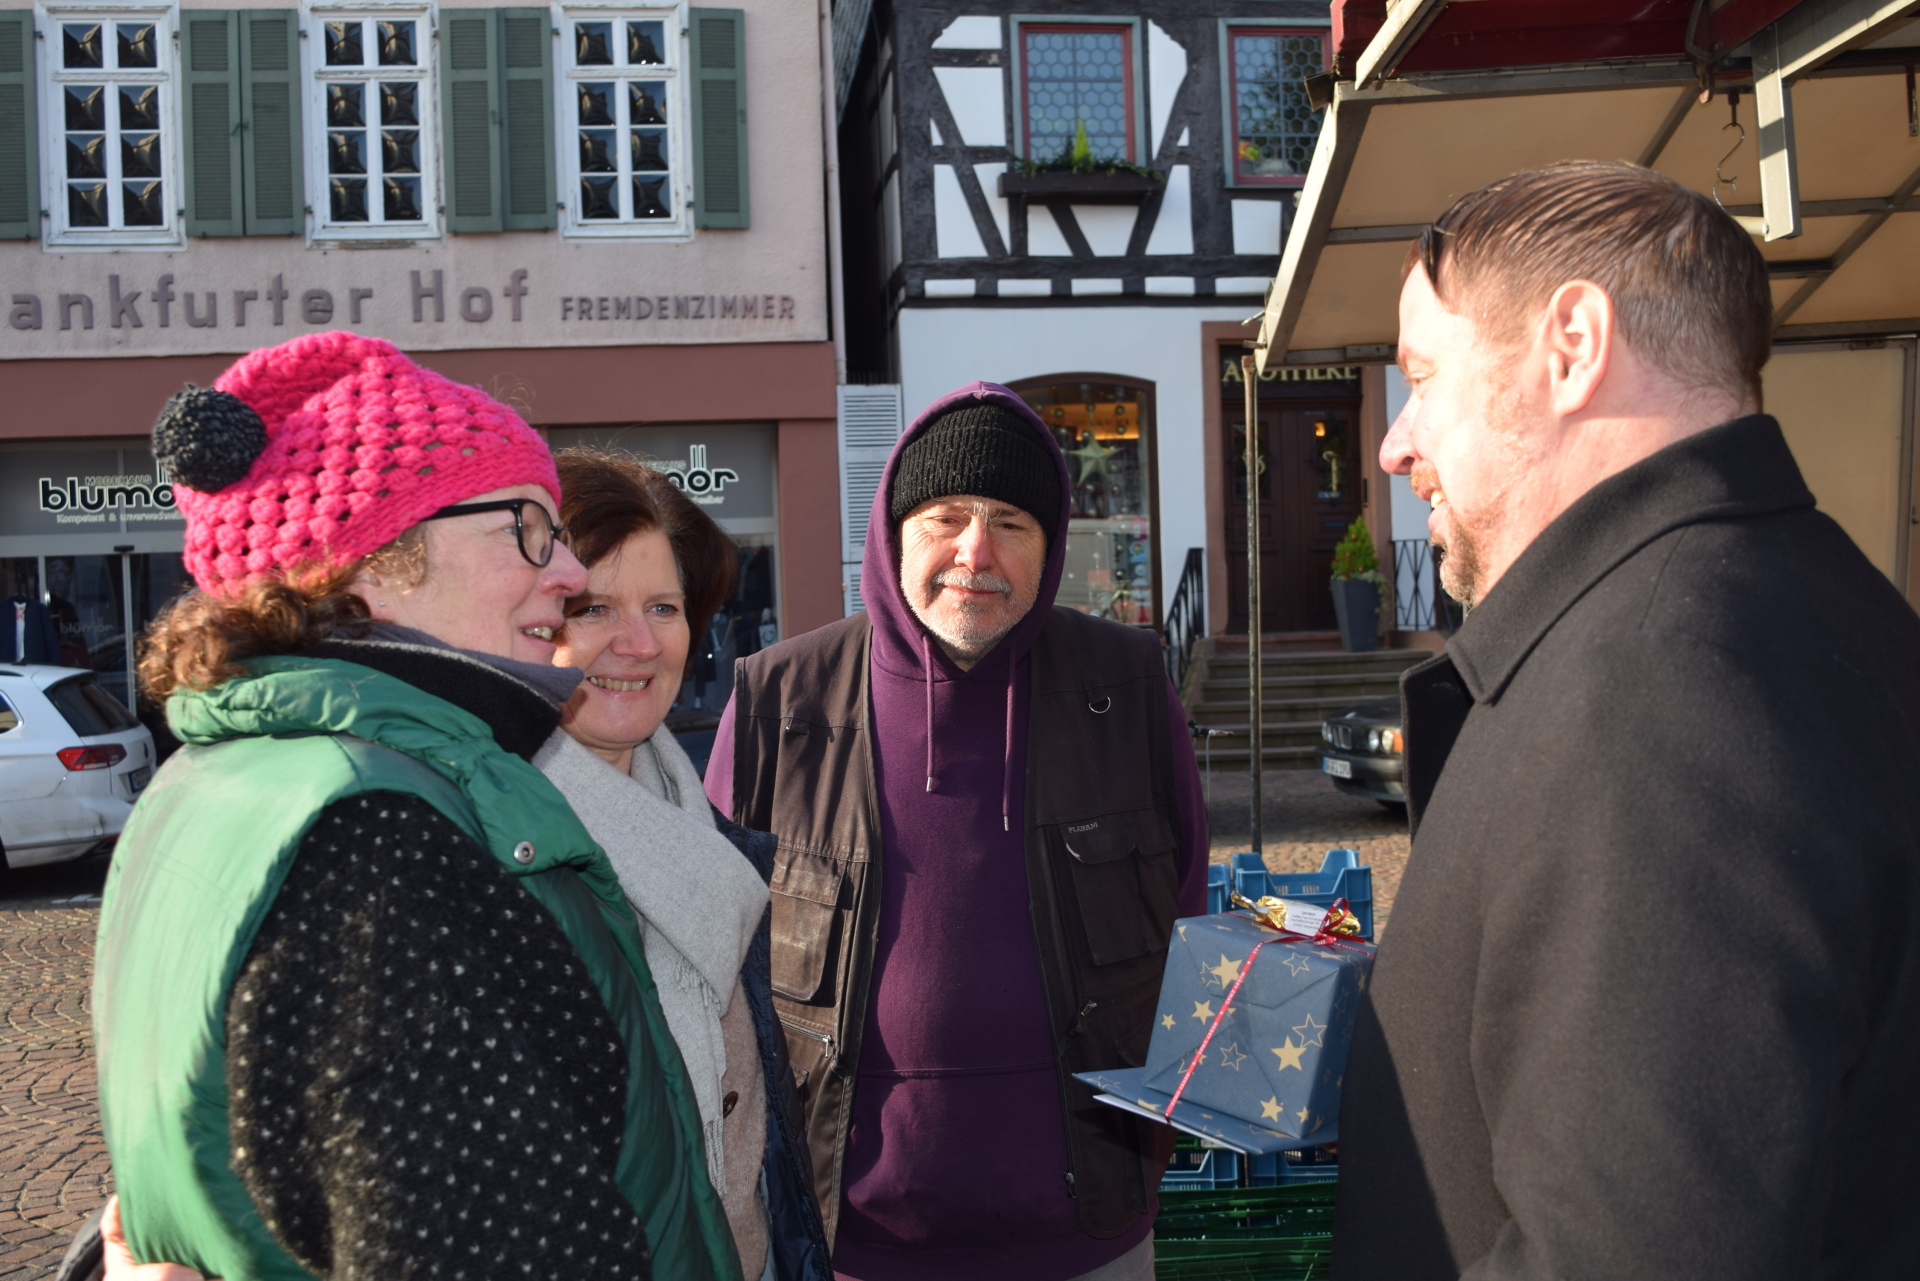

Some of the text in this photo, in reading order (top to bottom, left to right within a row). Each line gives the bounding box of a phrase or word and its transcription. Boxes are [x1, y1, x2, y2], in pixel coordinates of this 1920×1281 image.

[9, 269, 796, 331] ankfurter Hof FREMDENZIMMER
[39, 460, 178, 513] blumö
[1068, 821, 1098, 833] PLANAM
